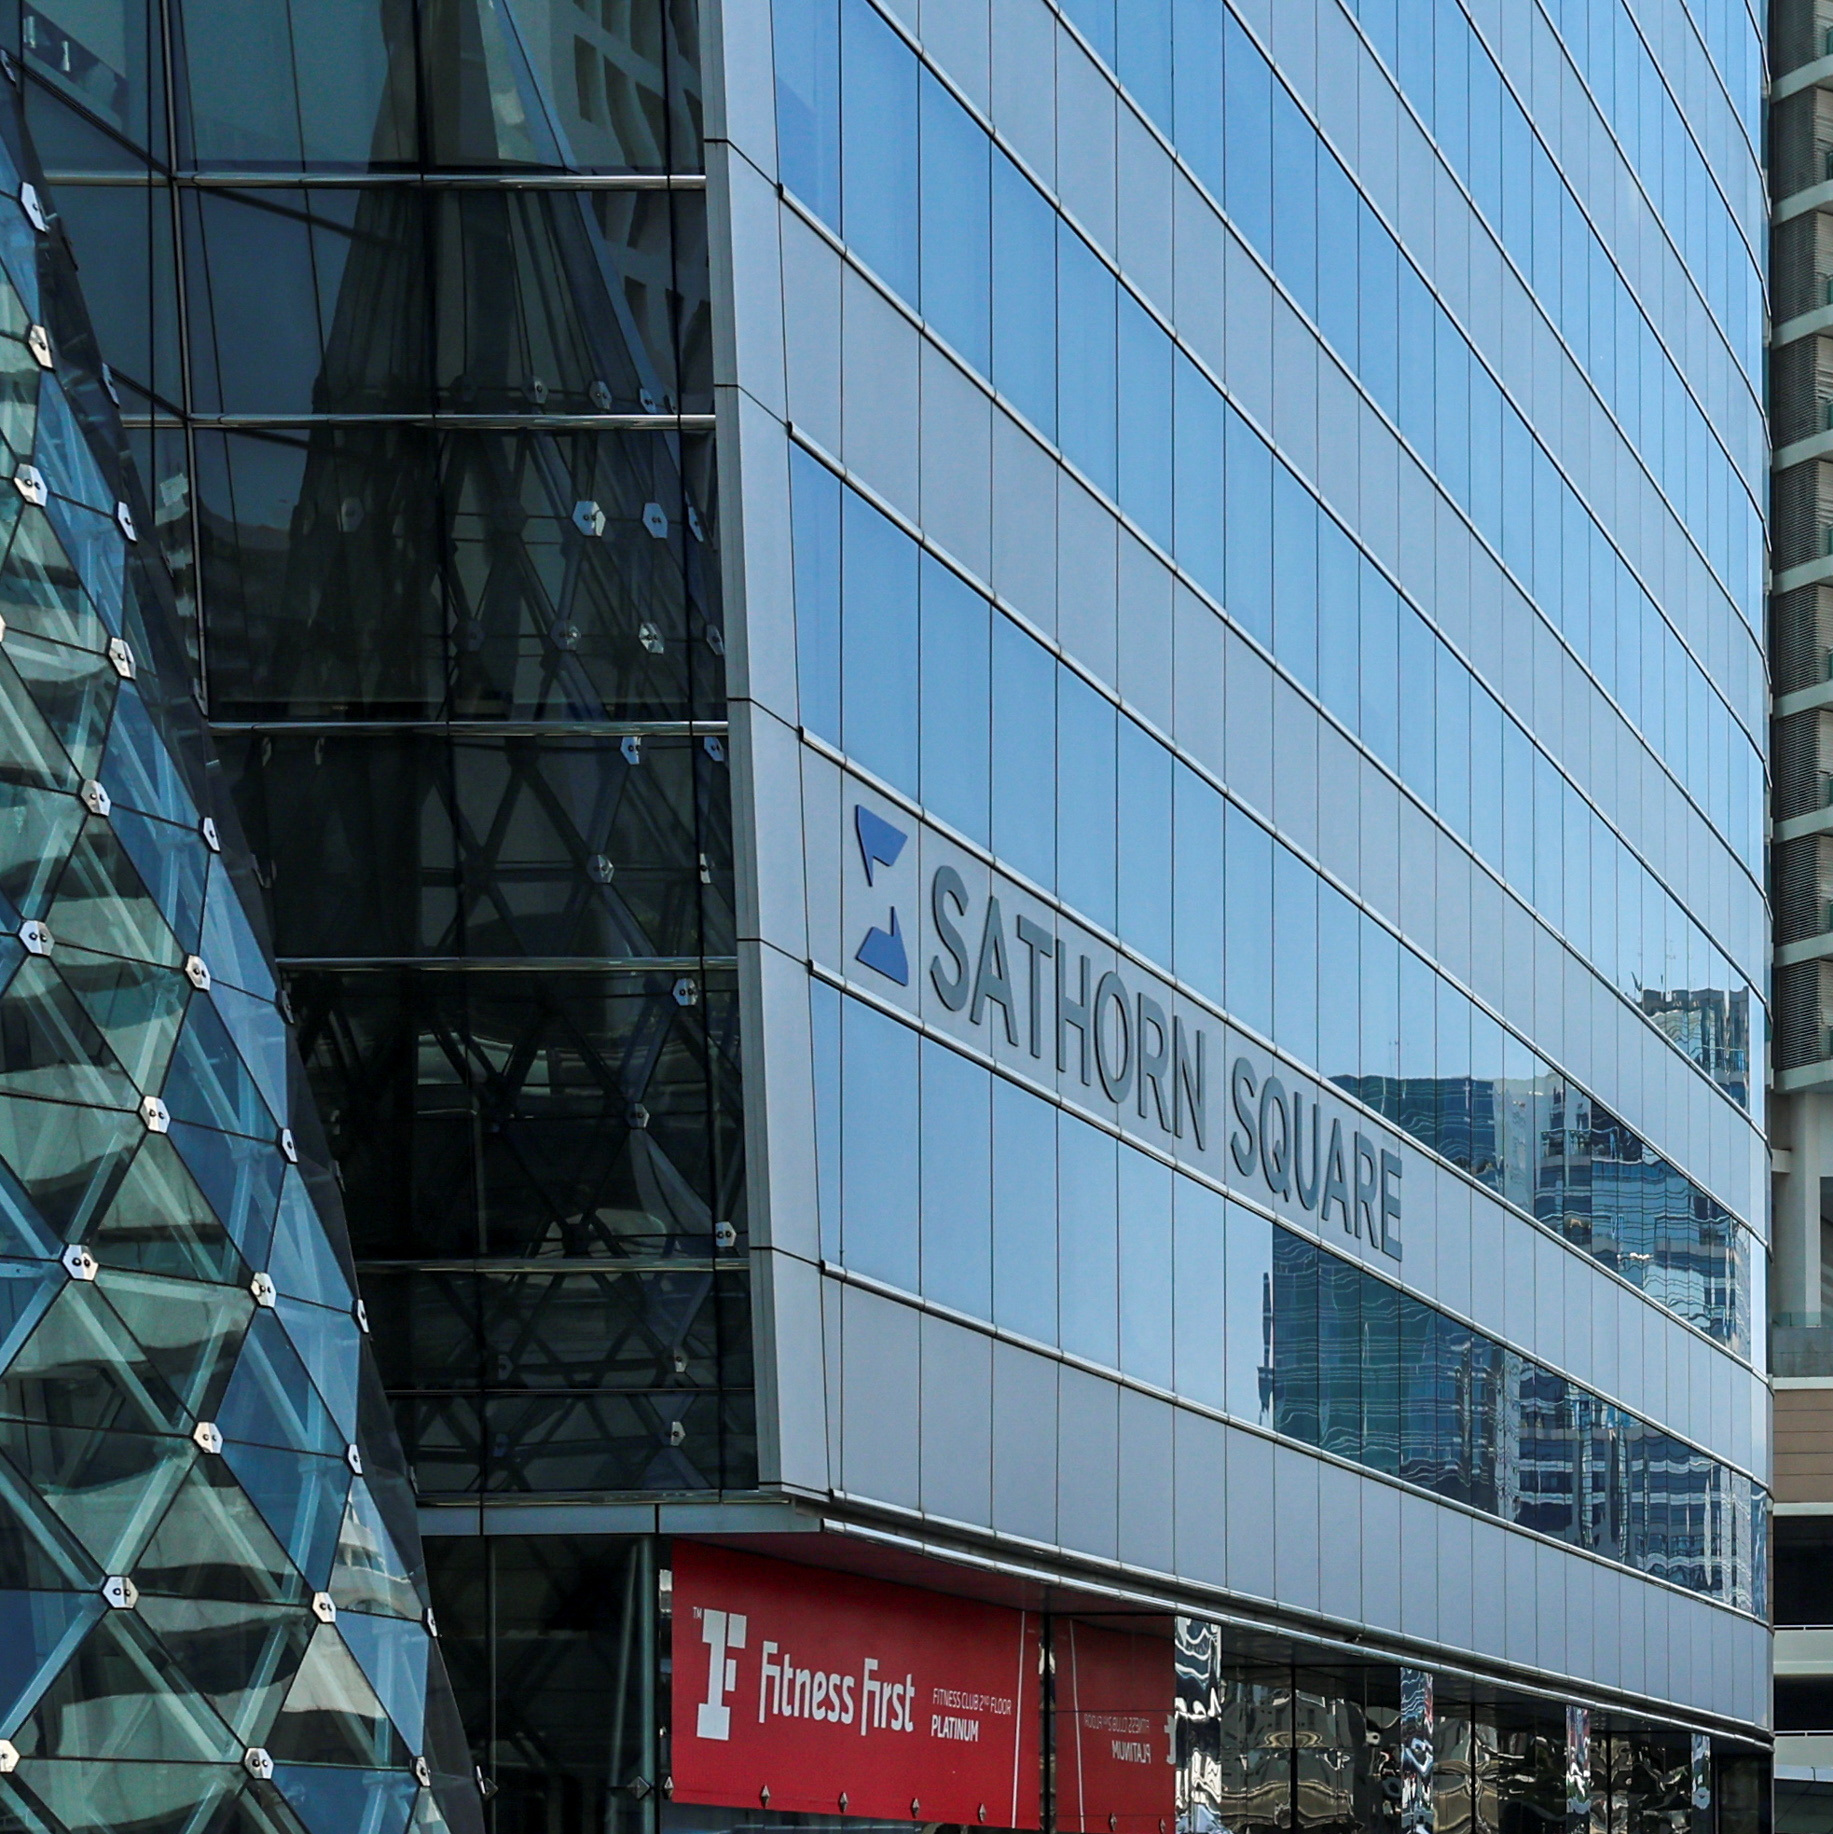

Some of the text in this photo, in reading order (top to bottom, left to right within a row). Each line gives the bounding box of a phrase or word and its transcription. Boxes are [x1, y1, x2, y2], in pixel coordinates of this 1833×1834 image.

[930, 865, 1403, 1261] SATHORN SQUARE
[759, 1640, 915, 1736] Fitness First
[933, 1688, 960, 1710] FITNESS
[961, 1691, 978, 1712] CLUB
[990, 1696, 1011, 1715] FLOOR
[931, 1714, 978, 1742] PLATINUM
